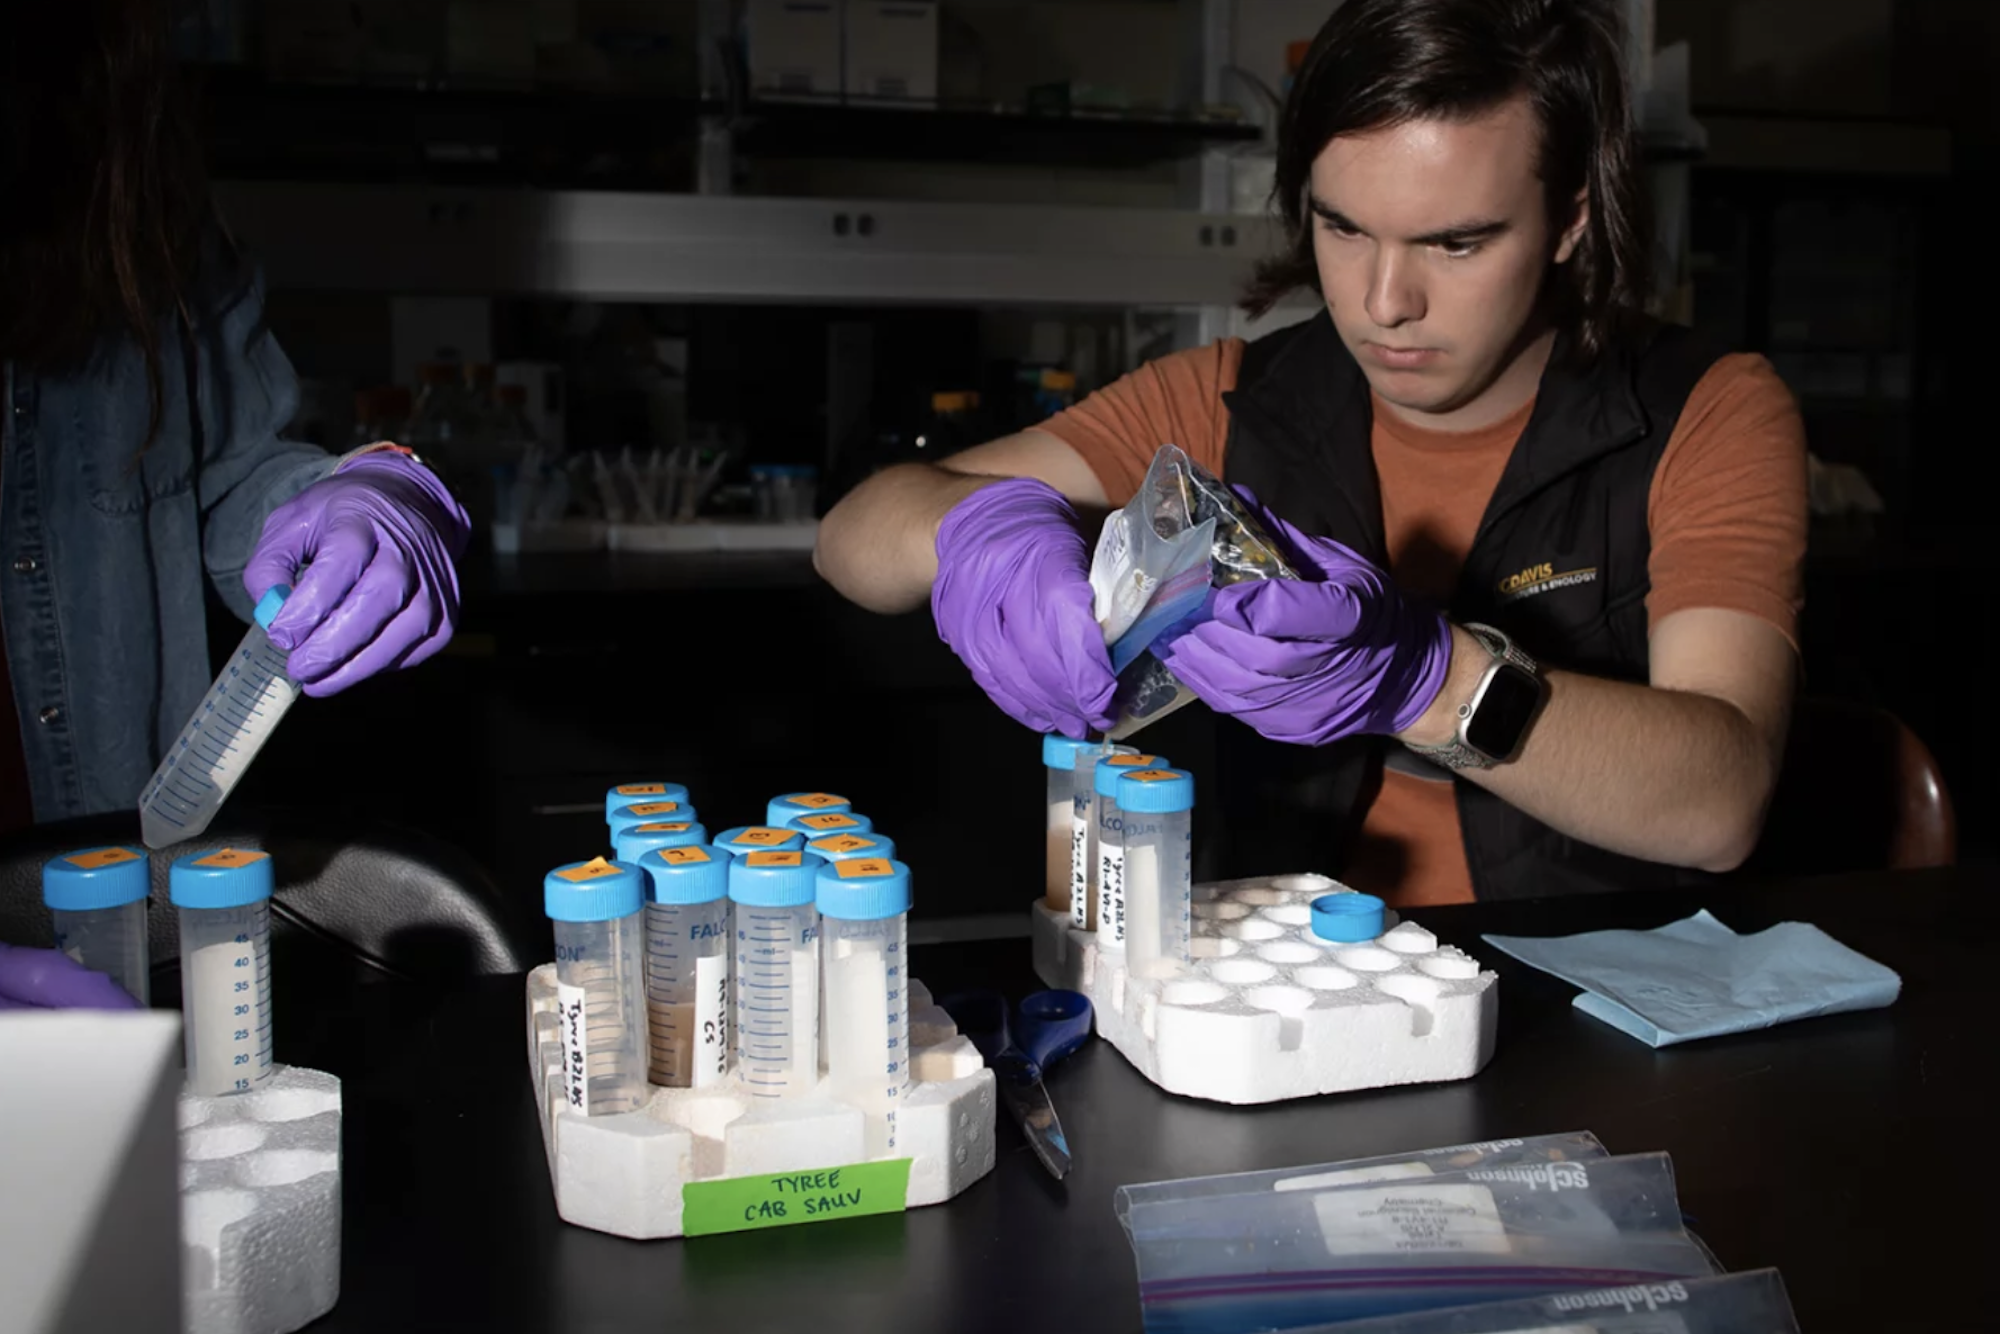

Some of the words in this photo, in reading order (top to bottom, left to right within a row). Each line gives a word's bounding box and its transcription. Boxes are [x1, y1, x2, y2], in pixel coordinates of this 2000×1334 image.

[234, 932, 249, 944] 45
[234, 957, 250, 968] 40
[234, 981, 250, 992] 35
[887, 990, 899, 1001] 35
[234, 1005, 250, 1016] 30
[887, 1013, 899, 1024] 30
[234, 1029, 250, 1041] 25
[887, 1037, 899, 1049] 25
[234, 1054, 250, 1066] 20
[887, 1062, 899, 1073] 20
[234, 1079, 250, 1090] 15
[887, 1087, 899, 1098] 15
[771, 1169, 842, 1193] TYREE
[744, 1200, 787, 1222] CAB
[803, 1188, 862, 1215] SAUV
